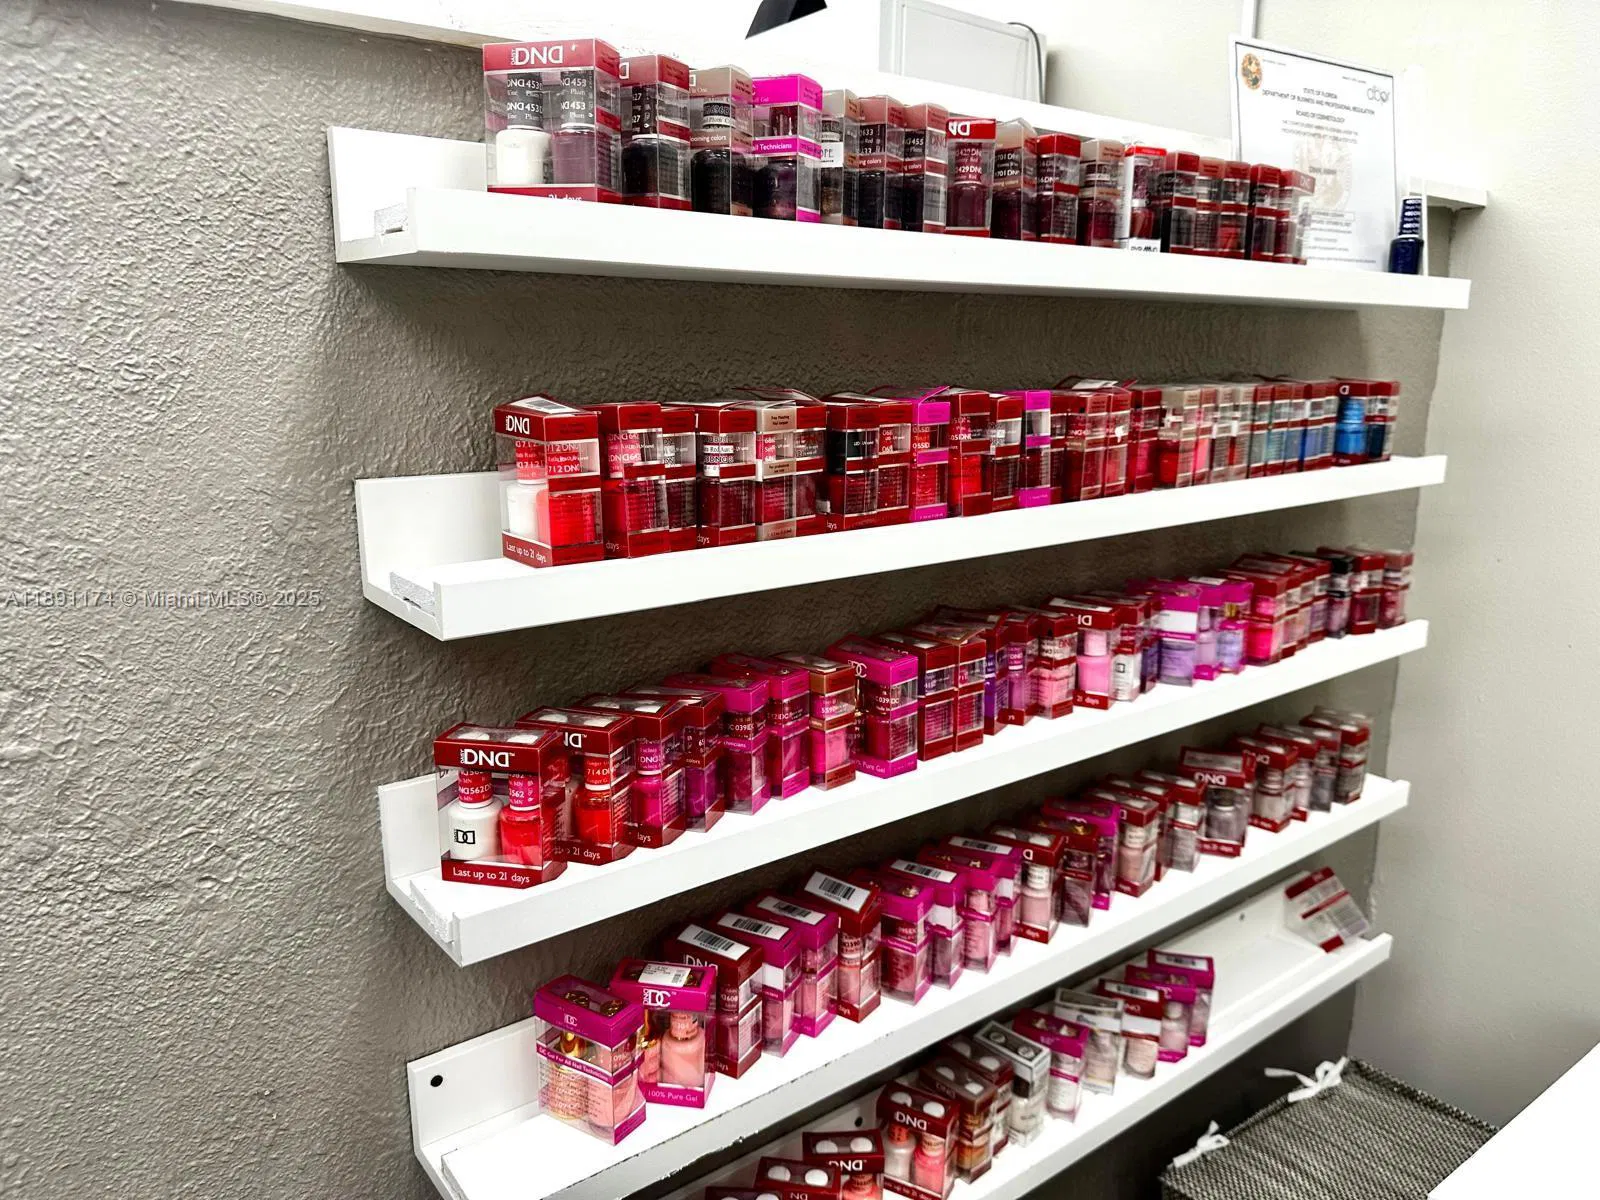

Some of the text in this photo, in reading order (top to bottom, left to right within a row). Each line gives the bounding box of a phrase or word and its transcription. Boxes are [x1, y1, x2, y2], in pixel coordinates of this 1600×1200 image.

[571, 102, 586, 110] 453
[760, 142, 792, 151] Technicians
[697, 534, 710, 544] days
[606, 542, 620, 550] days
[506, 542, 516, 553] Last
[536, 551, 547, 563] days
[464, 748, 510, 768] DND
[863, 761, 875, 772] Pure
[512, 789, 524, 798] 562
[572, 846, 600, 860] 21 days
[453, 868, 471, 877] Last
[473, 871, 484, 880] up
[499, 872, 507, 880] 21
[512, 874, 530, 884] days
[668, 1091, 684, 1102] Pure
[686, 1094, 698, 1102] Gel
[896, 1112, 927, 1131] DND
